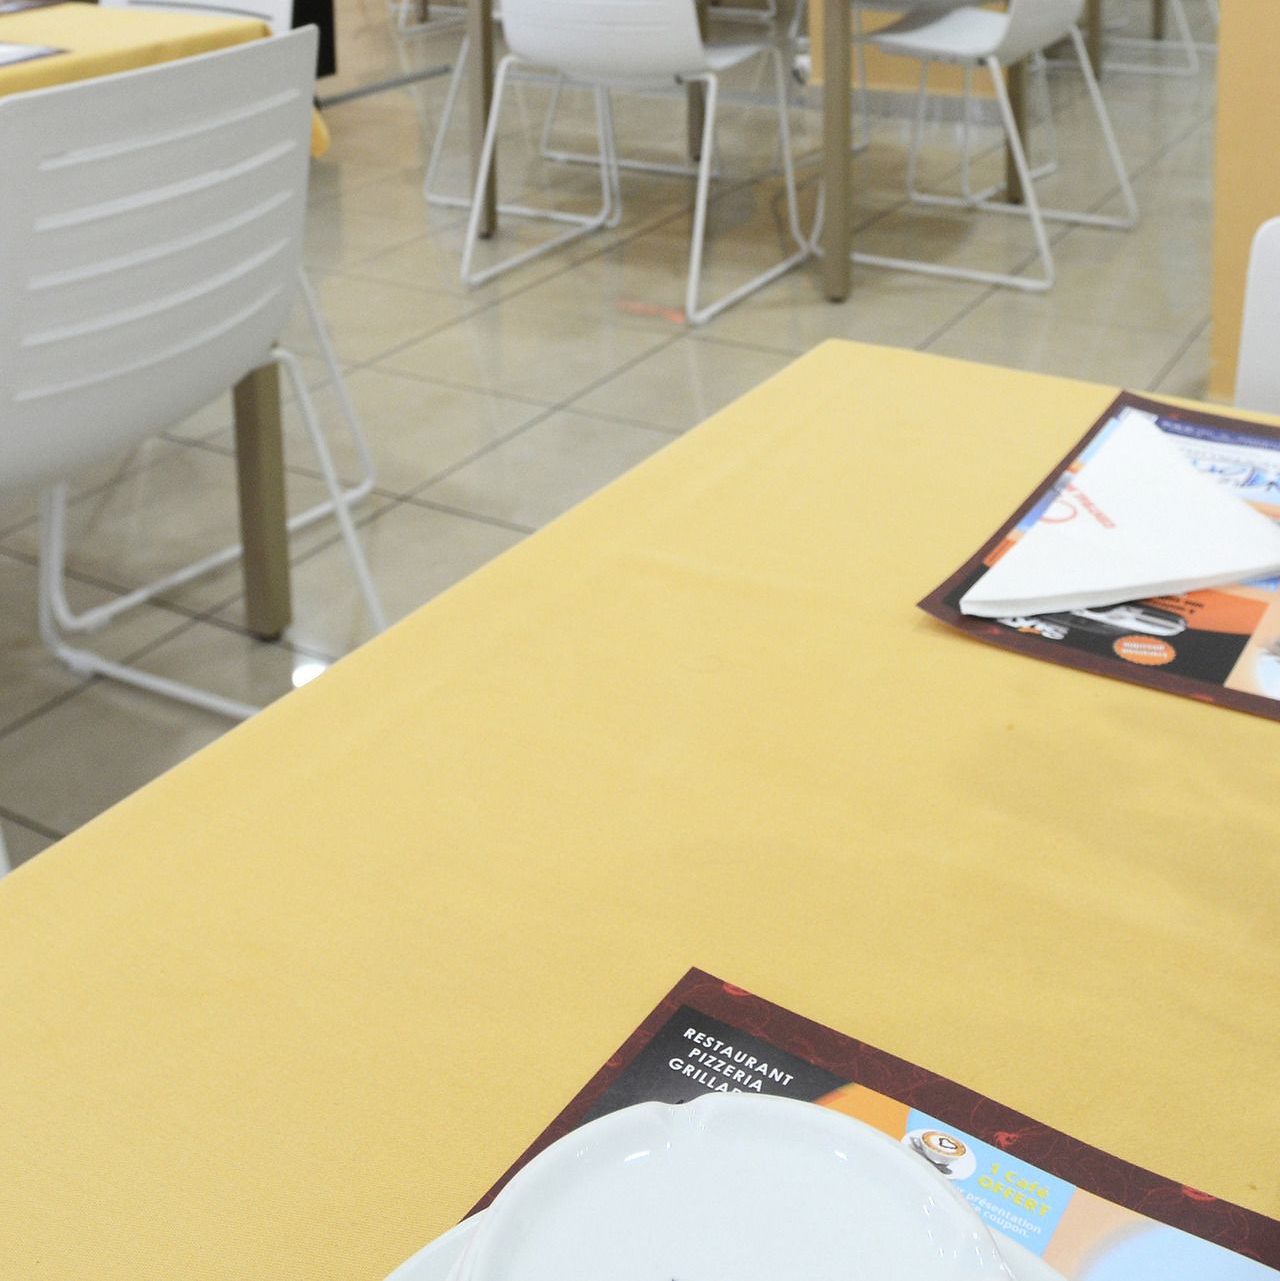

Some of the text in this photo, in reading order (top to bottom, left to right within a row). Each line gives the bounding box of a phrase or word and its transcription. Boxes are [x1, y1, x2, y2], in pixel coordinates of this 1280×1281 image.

[683, 1027, 794, 1087] RESTAURANT
[688, 1047, 763, 1093] PIZZERIA
[977, 1175, 1052, 1217] OFFERT
[1004, 1171, 1050, 1200] Café
[965, 1192, 1042, 1235] présentation
[983, 1210, 1030, 1239] coupon.
